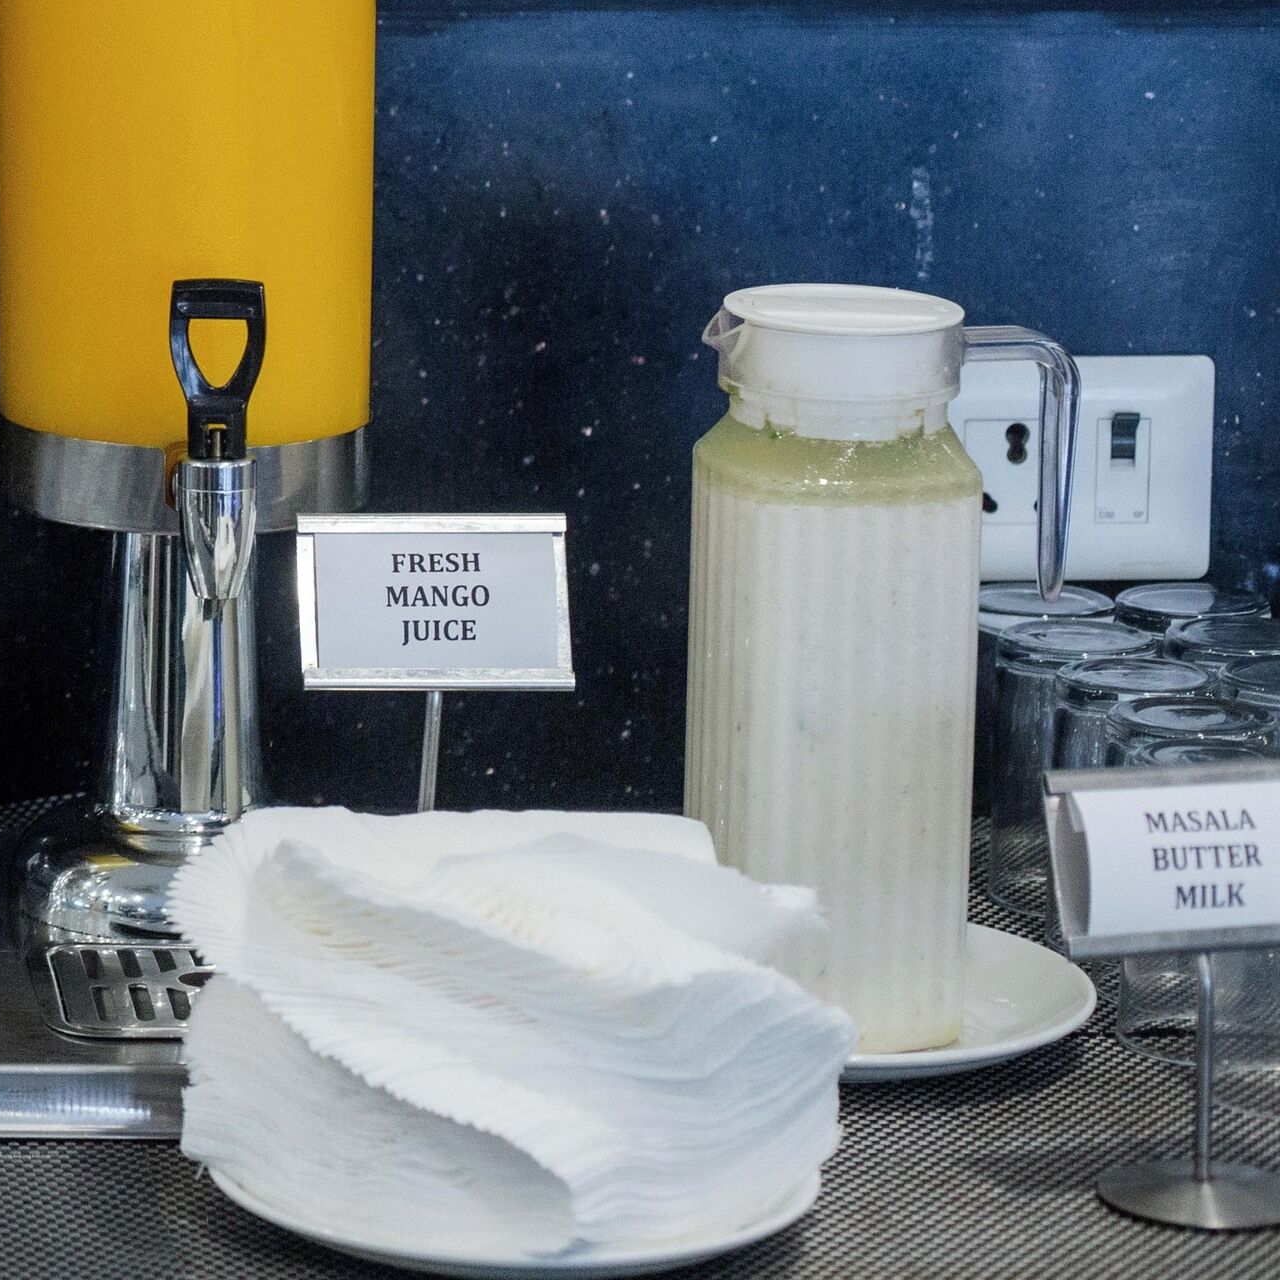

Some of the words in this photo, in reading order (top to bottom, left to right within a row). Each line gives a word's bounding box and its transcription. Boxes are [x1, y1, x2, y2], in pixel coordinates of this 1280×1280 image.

[391, 552, 481, 573] FRESH
[386, 585, 490, 607] MANGO
[401, 619, 477, 646] JUICE
[1144, 809, 1257, 834] MASALA
[1152, 844, 1263, 871] BUTTER
[1175, 883, 1246, 910] MILK
